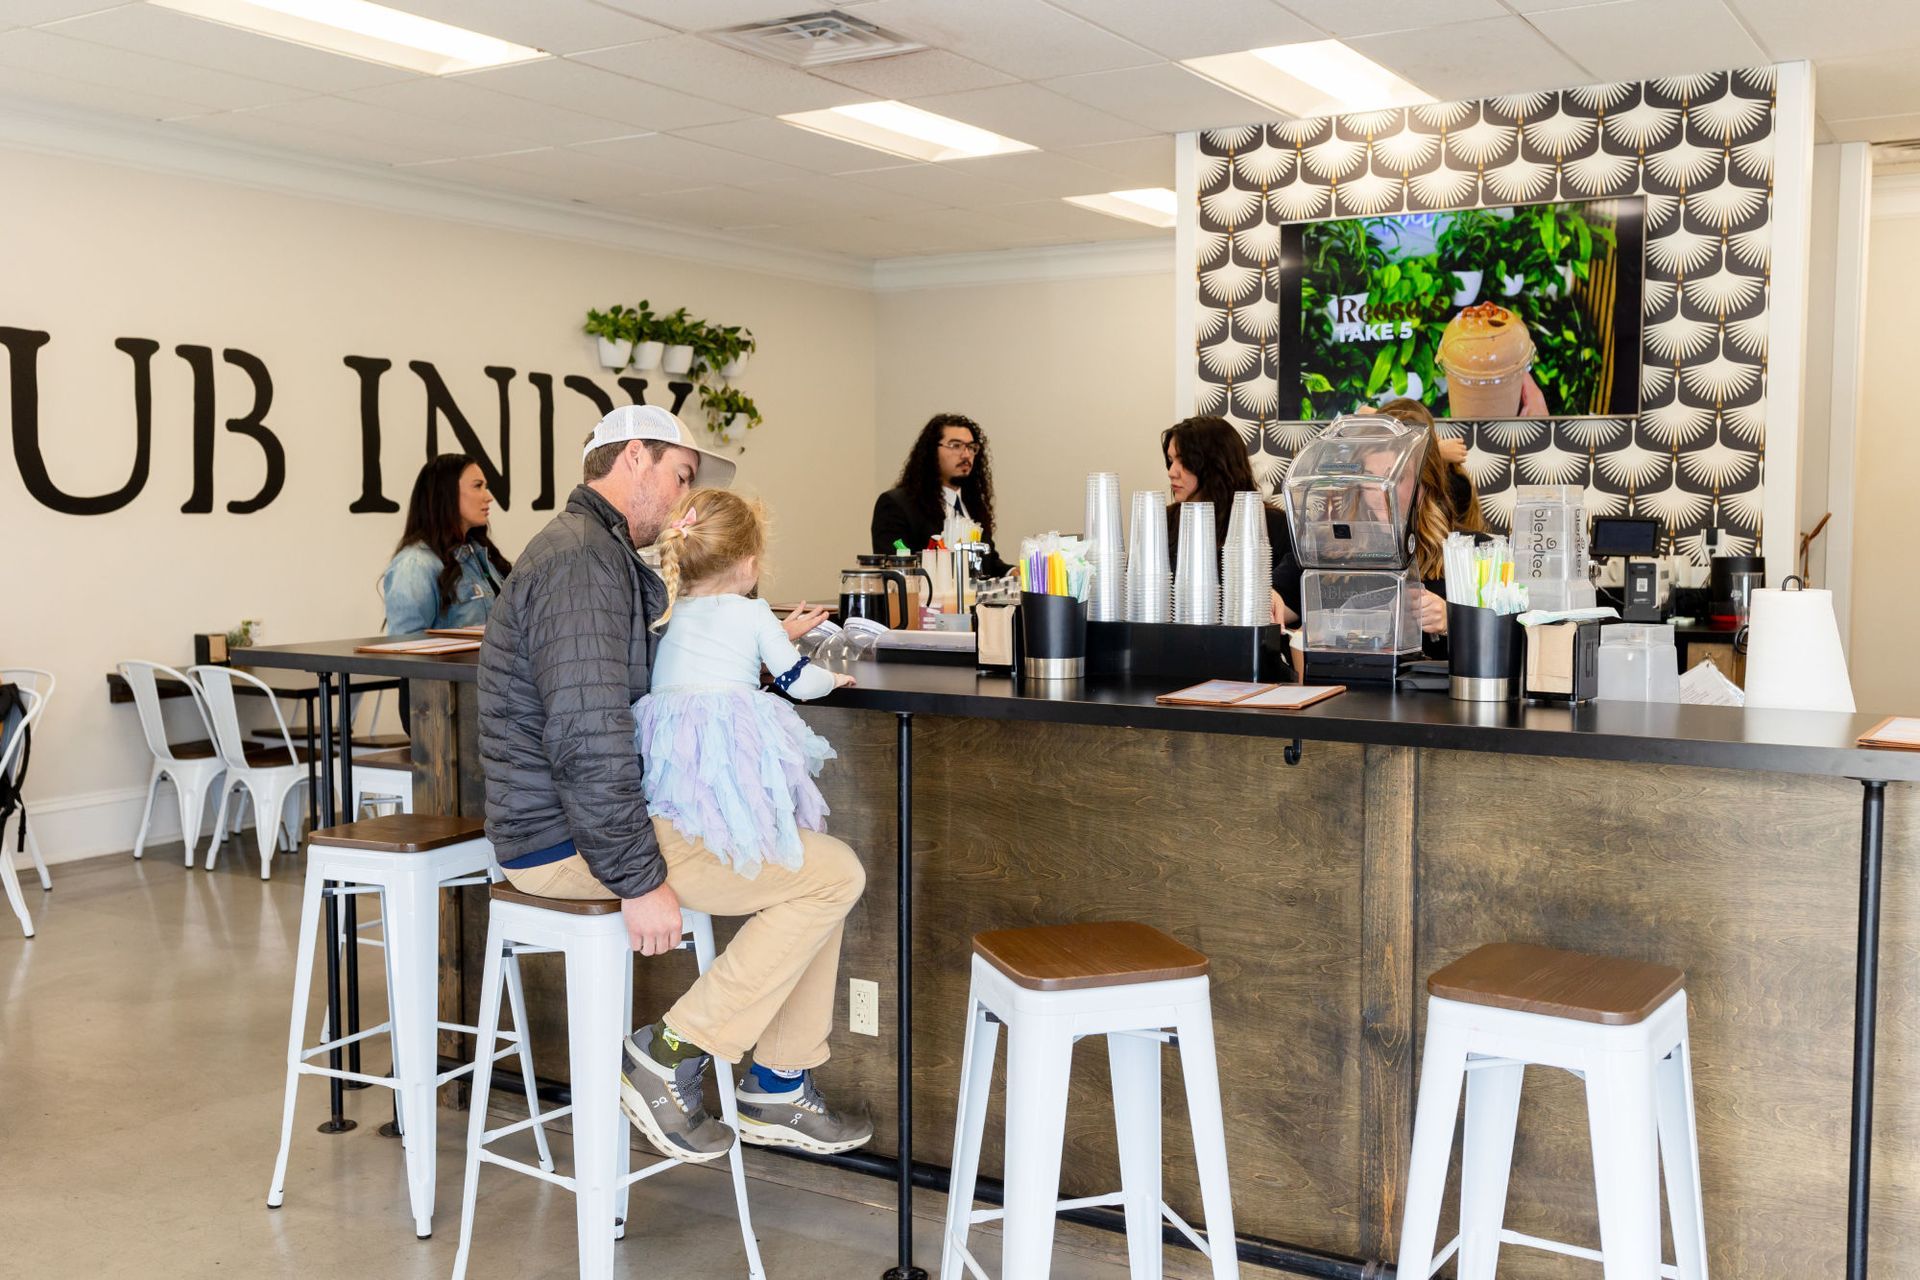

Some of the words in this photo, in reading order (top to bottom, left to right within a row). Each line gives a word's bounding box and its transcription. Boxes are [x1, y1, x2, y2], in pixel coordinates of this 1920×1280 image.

[1337, 291, 1451, 323] Reese's
[1338, 323, 1395, 343] TAKE
[1399, 322, 1414, 340] 5
[0, 326, 286, 516] UB
[343, 355, 694, 514] IND
[1532, 508, 1547, 578] blendtec
